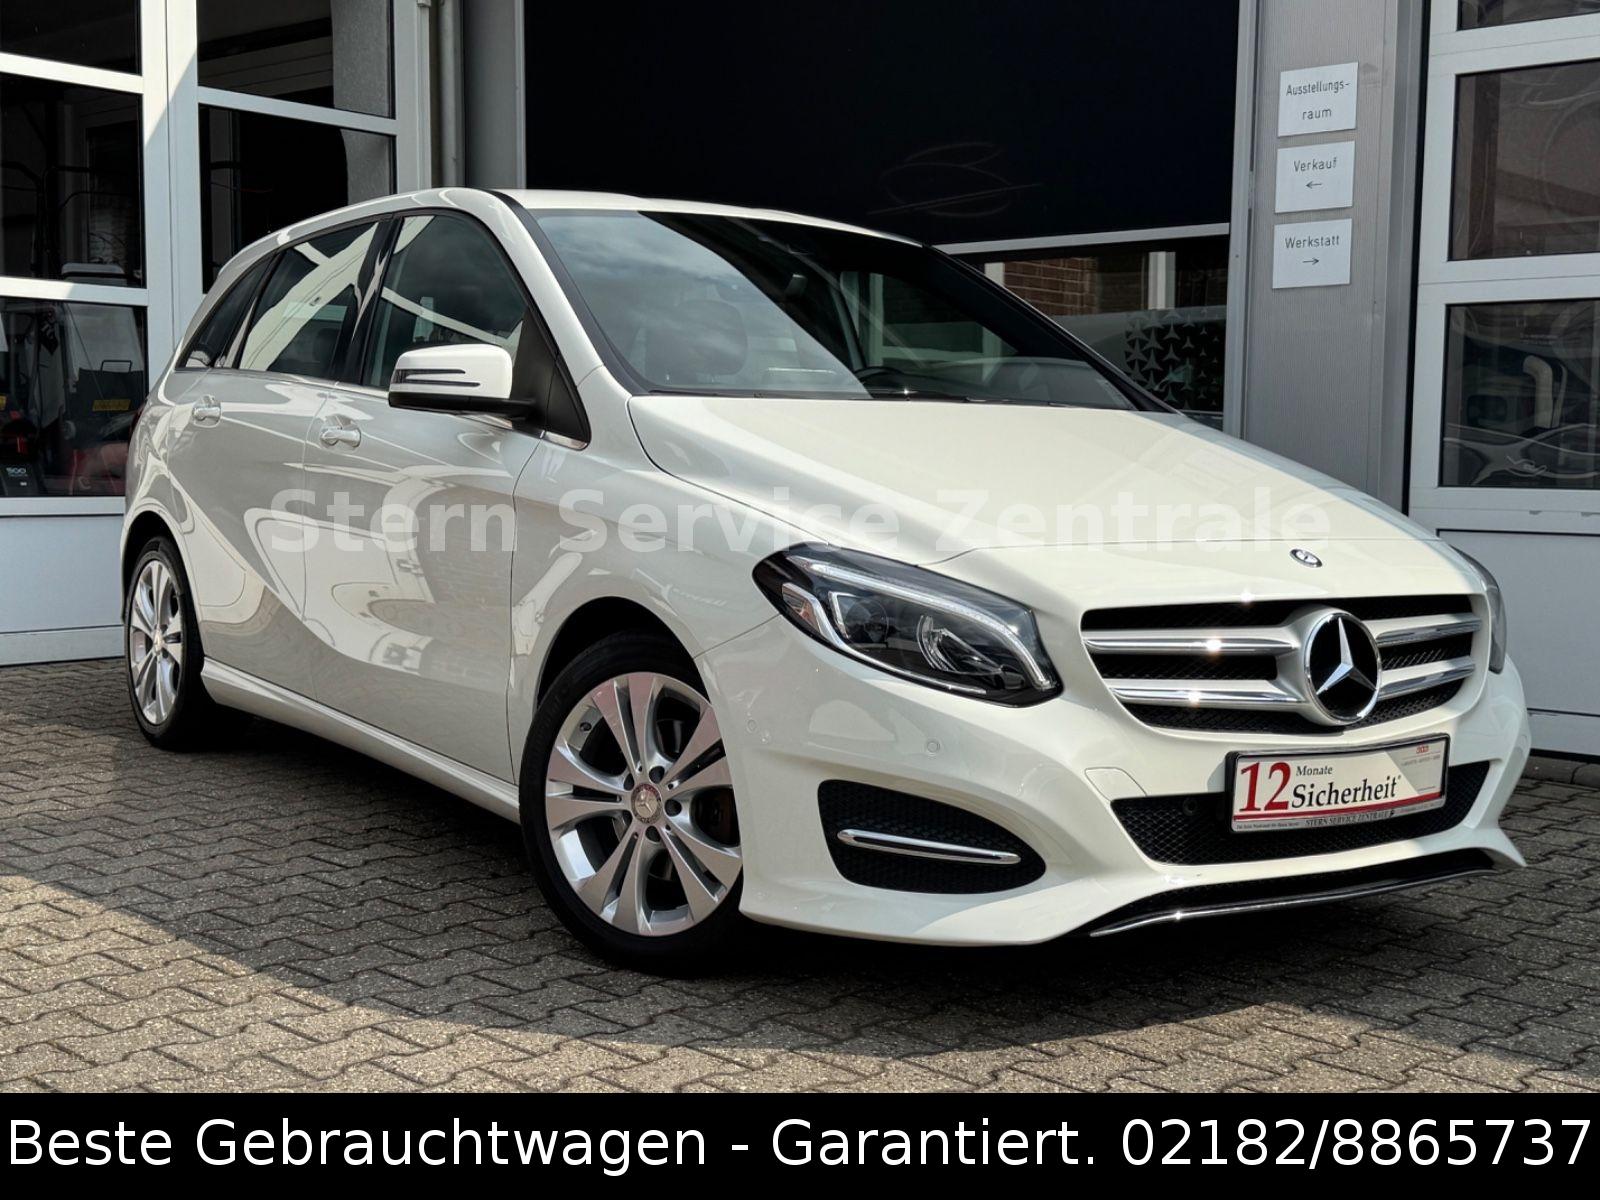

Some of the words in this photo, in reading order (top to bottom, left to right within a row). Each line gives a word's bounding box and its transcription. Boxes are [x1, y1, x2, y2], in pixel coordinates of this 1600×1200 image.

[1286, 79, 1350, 96] Ausstellungs-
[1302, 107, 1332, 120] raum
[1293, 157, 1337, 172] Verkauf
[1285, 235, 1340, 249] Werkstatt
[1296, 765, 1333, 777] Monate
[1239, 761, 1291, 812] 12
